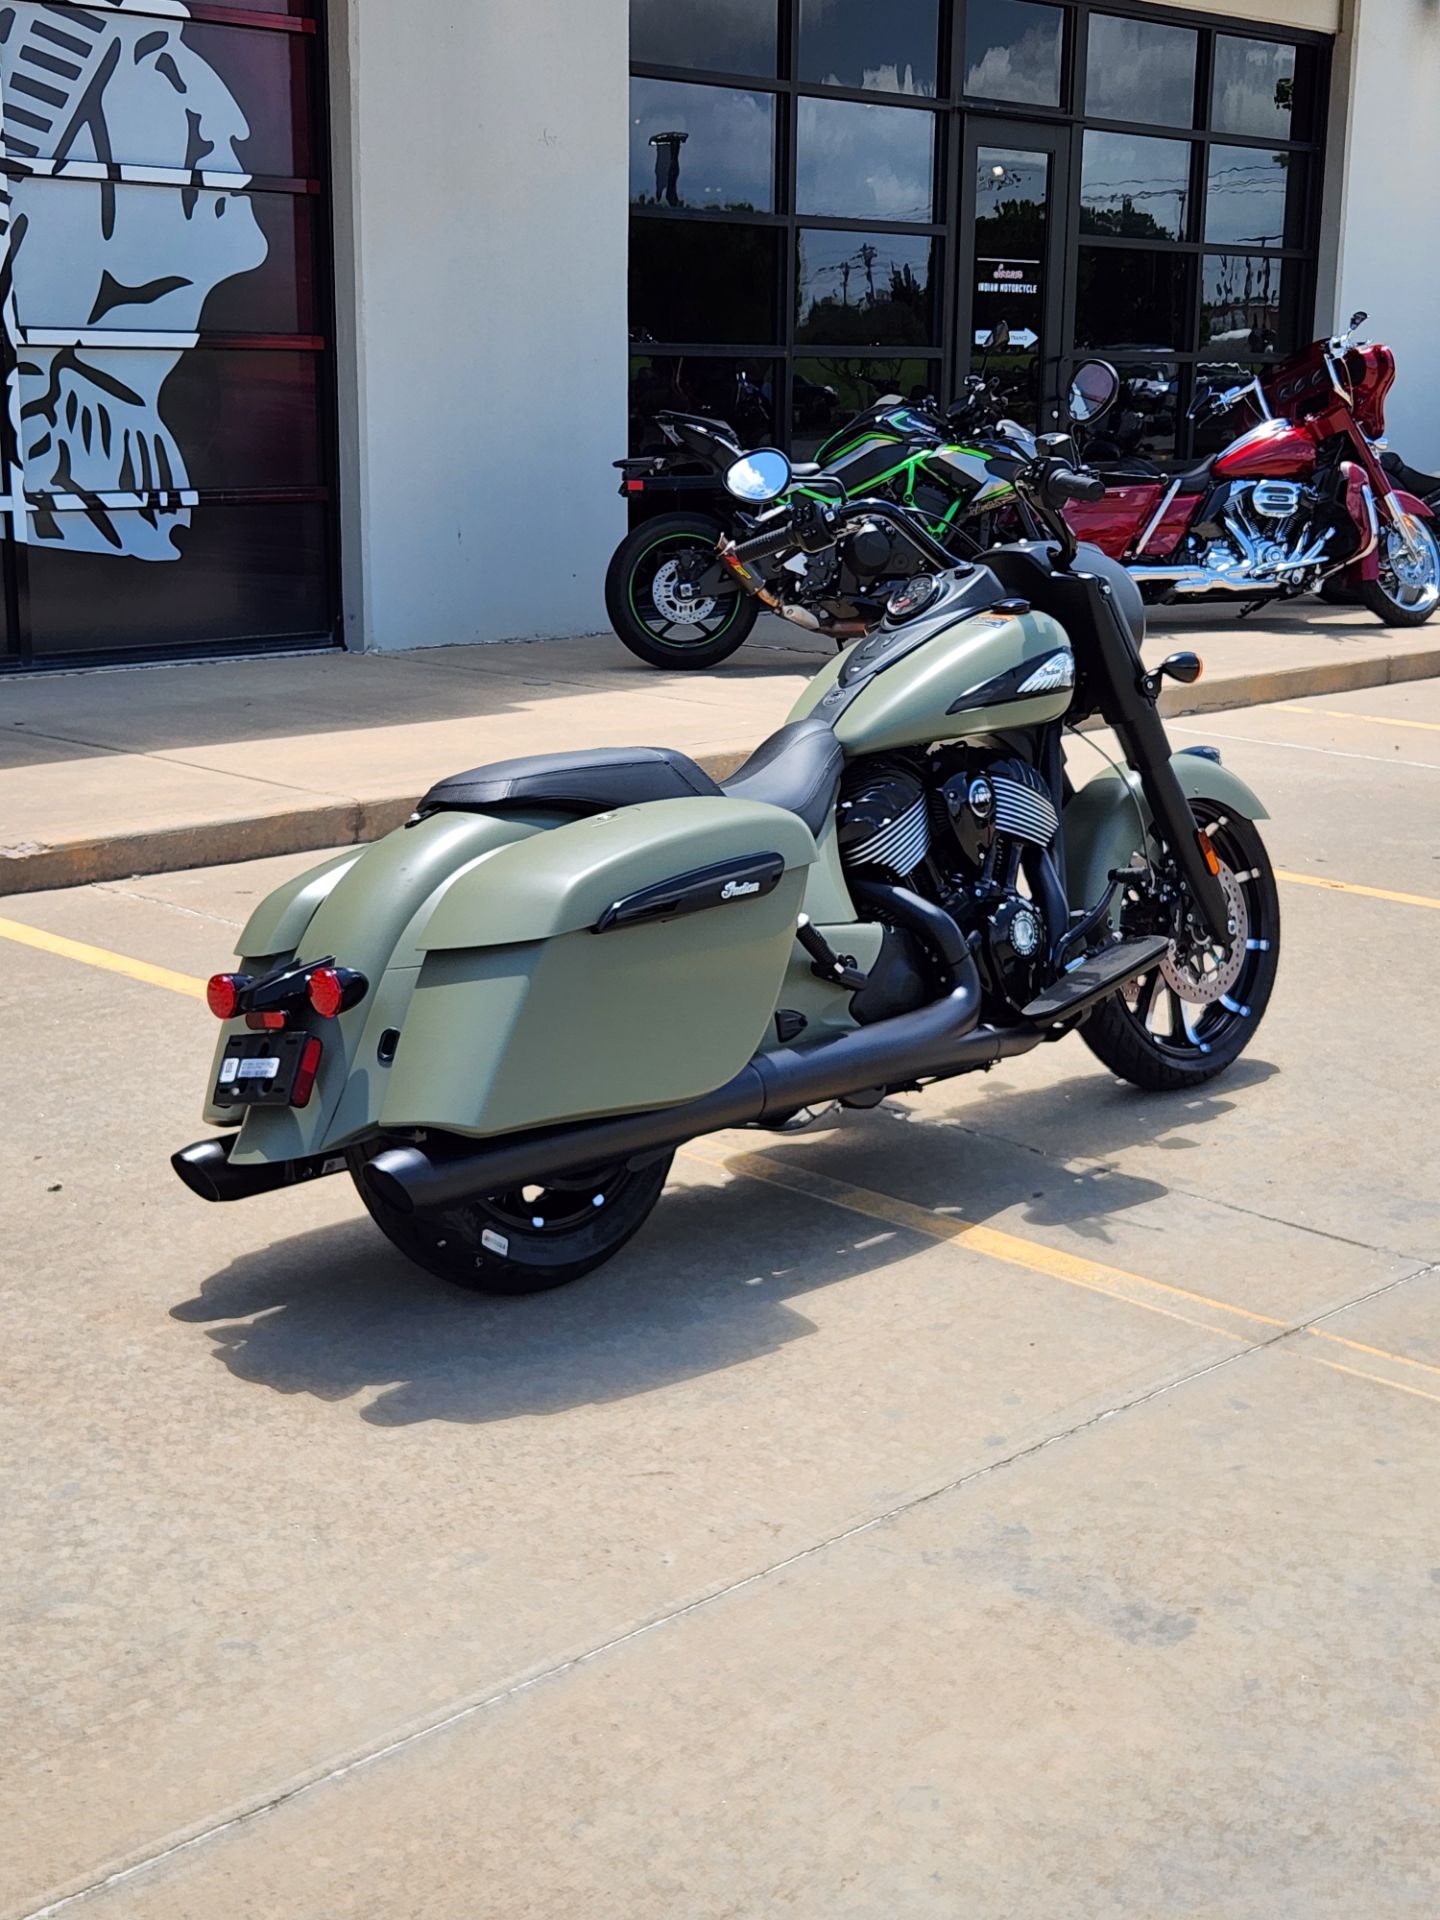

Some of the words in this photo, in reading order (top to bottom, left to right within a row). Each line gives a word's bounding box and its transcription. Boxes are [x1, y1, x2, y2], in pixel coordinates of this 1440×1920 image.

[978, 283, 998, 292] INDIAN
[1000, 283, 1037, 293] MOTORCYCLE
[721, 881, 760, 899] Indian
